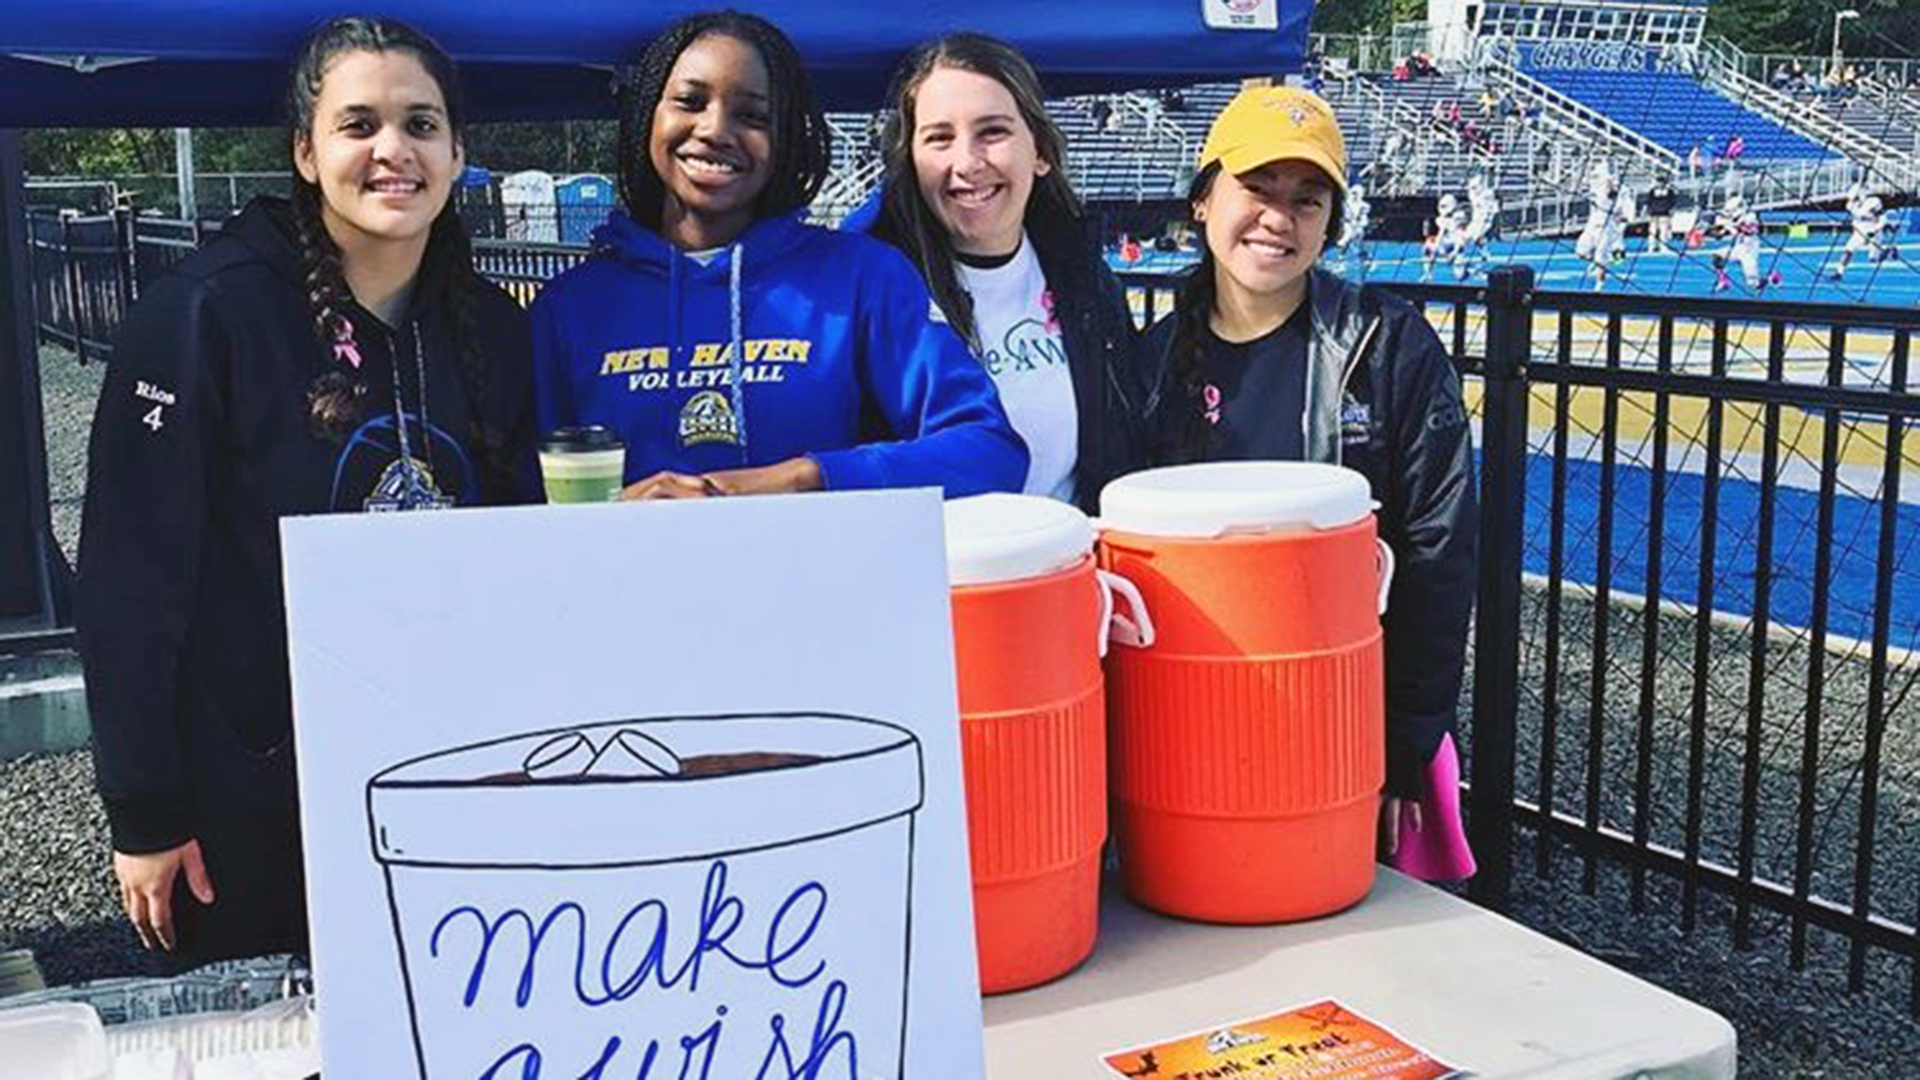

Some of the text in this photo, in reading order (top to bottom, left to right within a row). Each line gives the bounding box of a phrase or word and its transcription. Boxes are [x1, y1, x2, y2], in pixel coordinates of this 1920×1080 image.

[689, 339, 812, 367] HAVEN
[135, 380, 176, 405] Rios
[142, 405, 164, 431] 4
[431, 860, 827, 1007] make
